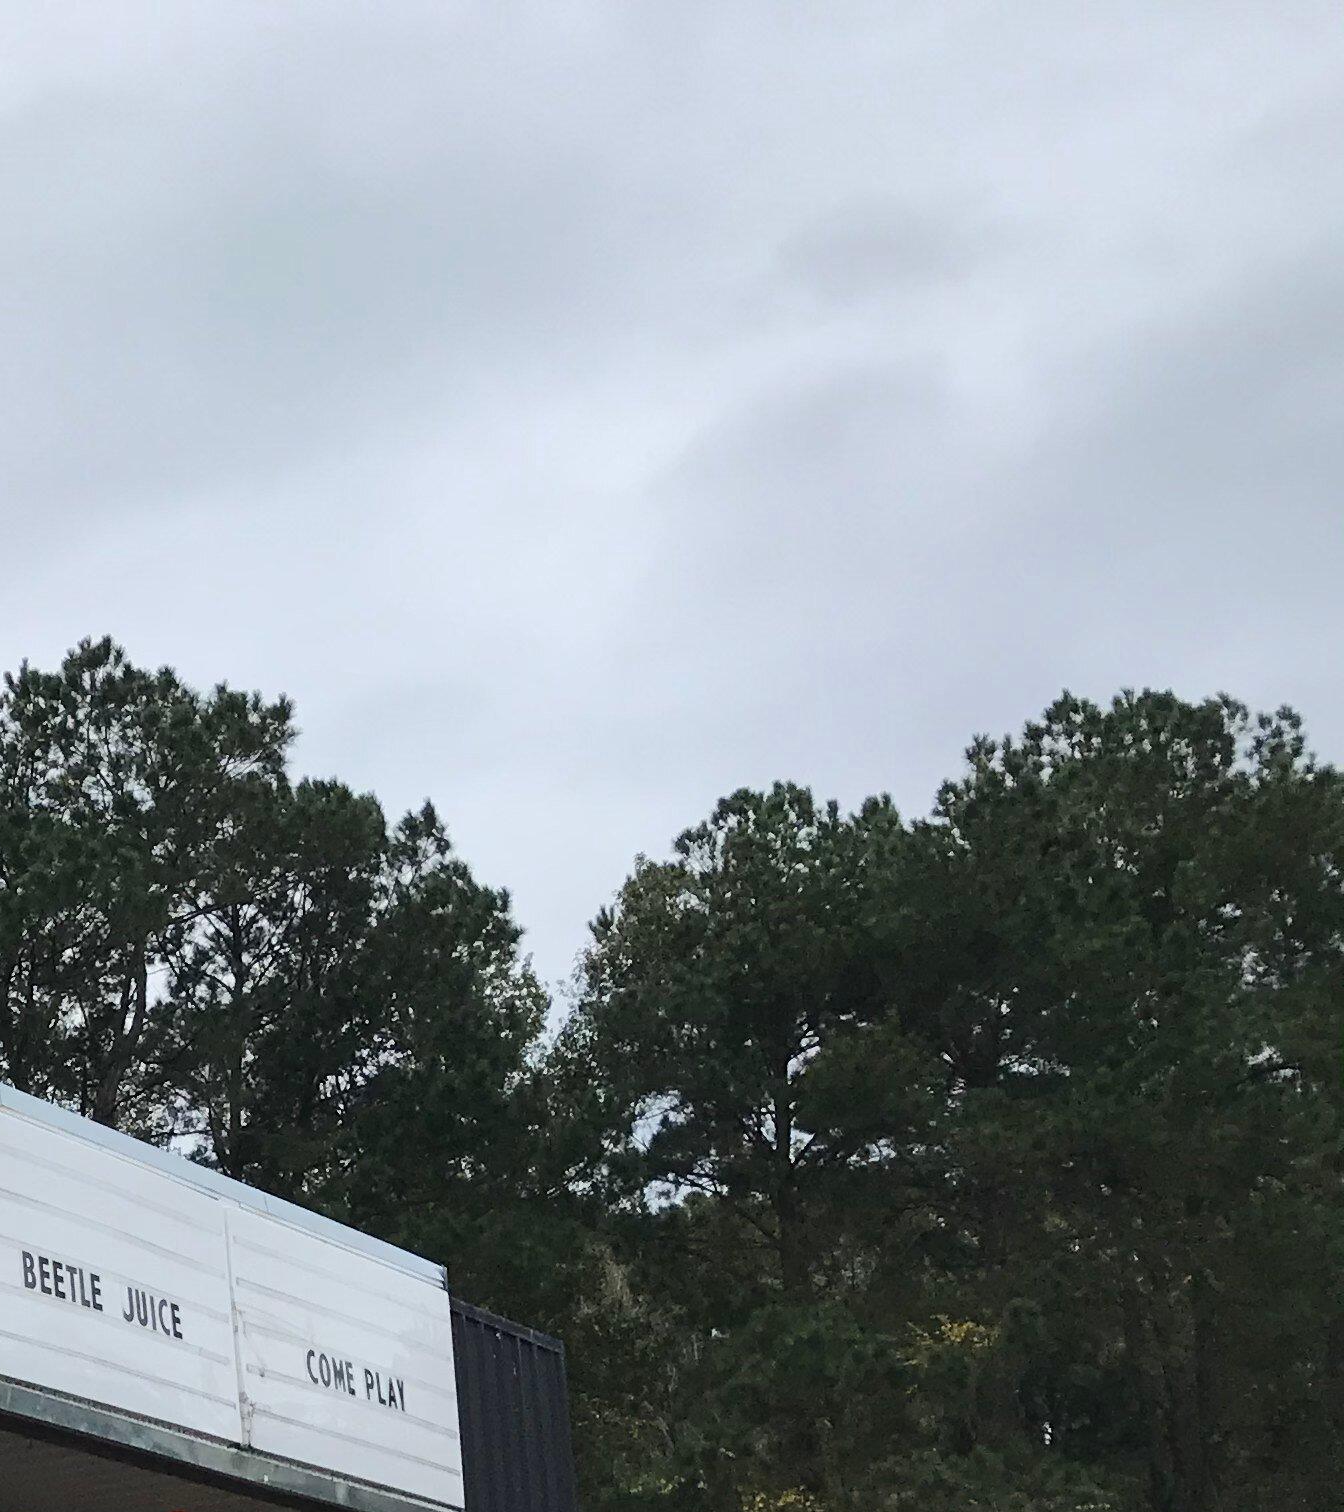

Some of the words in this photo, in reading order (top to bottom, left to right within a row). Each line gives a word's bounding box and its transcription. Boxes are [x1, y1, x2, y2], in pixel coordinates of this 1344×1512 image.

[21, 1250, 104, 1312] BEETLE
[123, 1286, 183, 1340] JUICE
[306, 1348, 356, 1397] COME
[363, 1367, 405, 1412] PLAY
